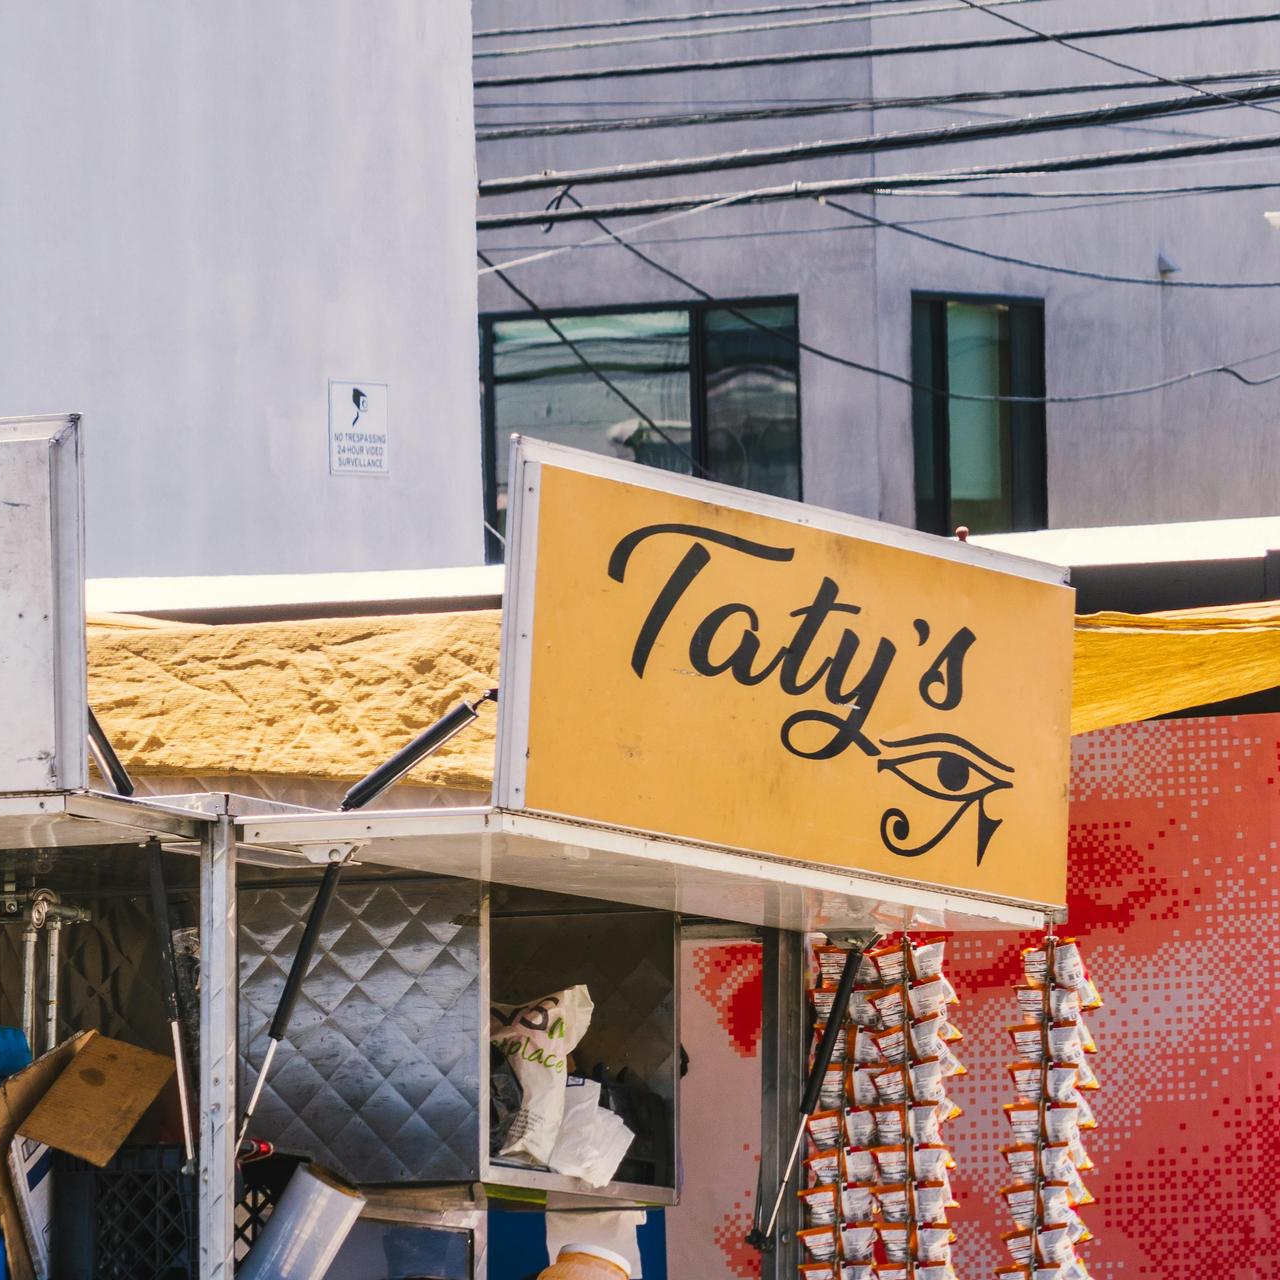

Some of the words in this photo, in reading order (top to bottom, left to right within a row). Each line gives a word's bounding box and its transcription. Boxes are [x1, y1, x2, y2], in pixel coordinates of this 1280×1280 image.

[334, 432, 344, 442] NO
[345, 432, 386, 444] TRESPASSING
[366, 446, 384, 456] VIDEO
[338, 457, 383, 468] SURVEILLANCE
[606, 523, 977, 760] Taty's
